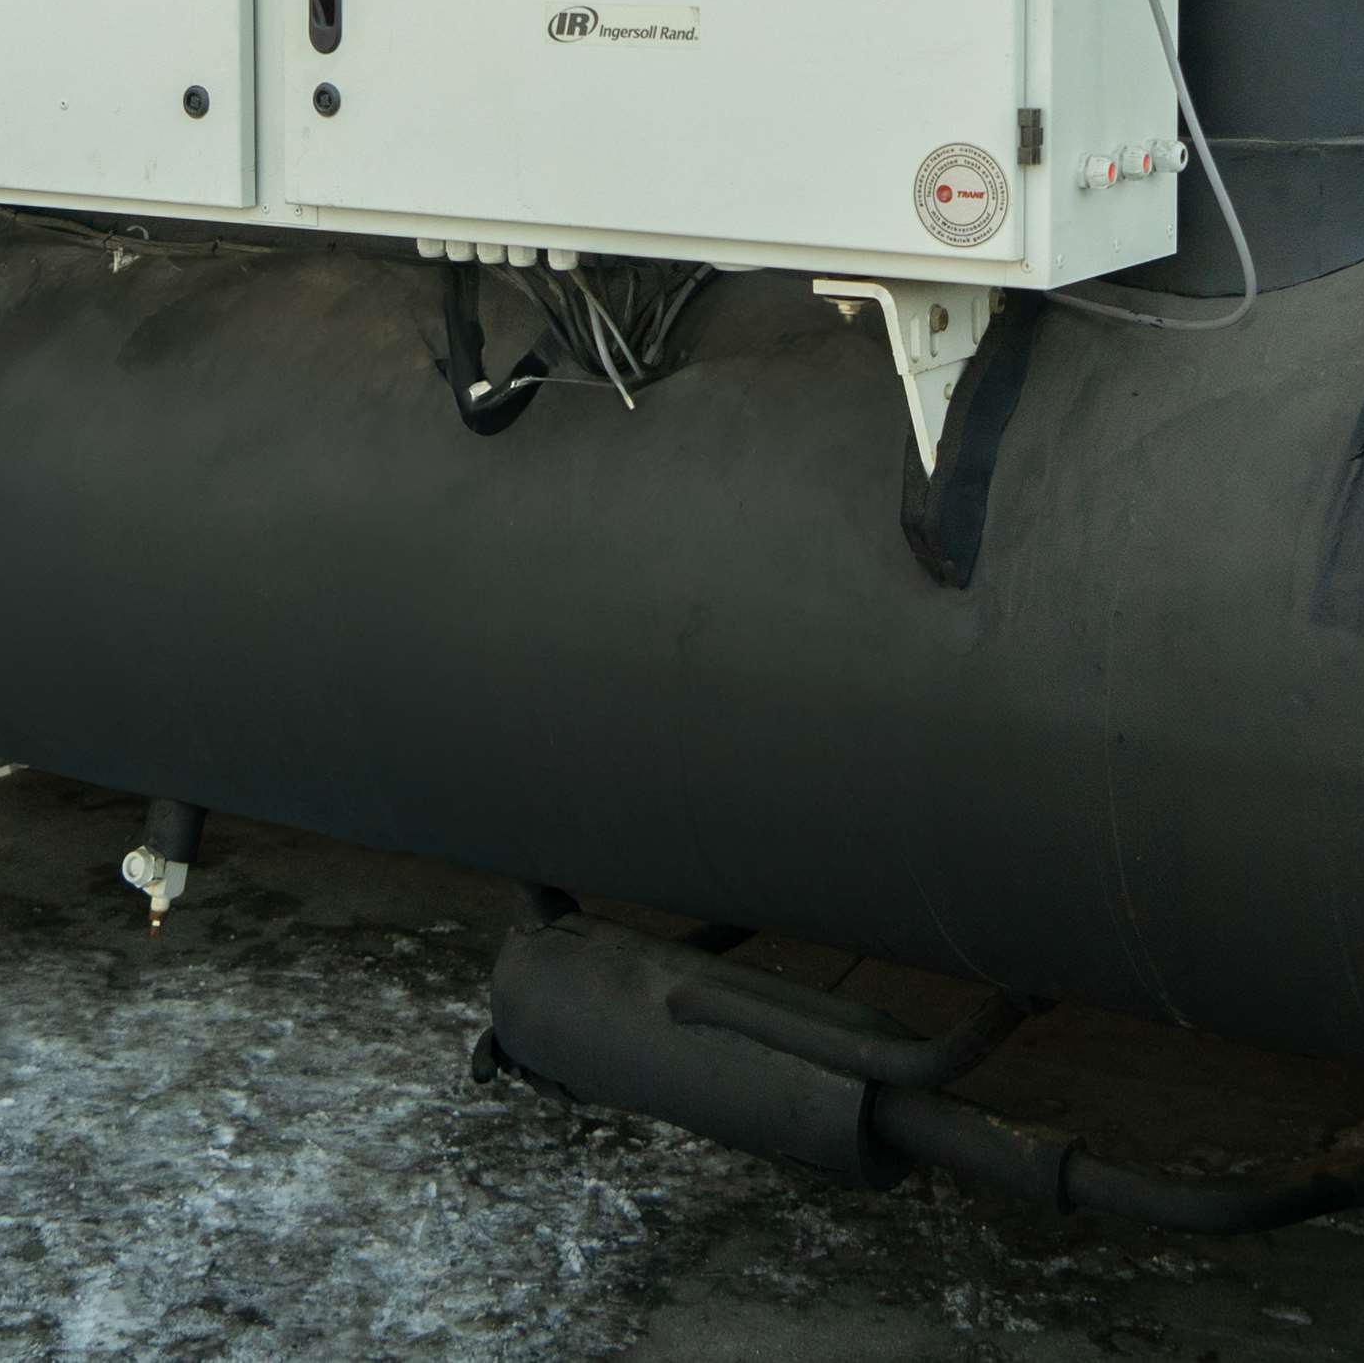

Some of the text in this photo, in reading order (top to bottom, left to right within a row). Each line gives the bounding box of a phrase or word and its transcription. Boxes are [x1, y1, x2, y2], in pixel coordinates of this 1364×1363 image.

[555, 12, 591, 37] IR
[599, 25, 658, 41] Ingersoll
[957, 190, 986, 200] TRANE
